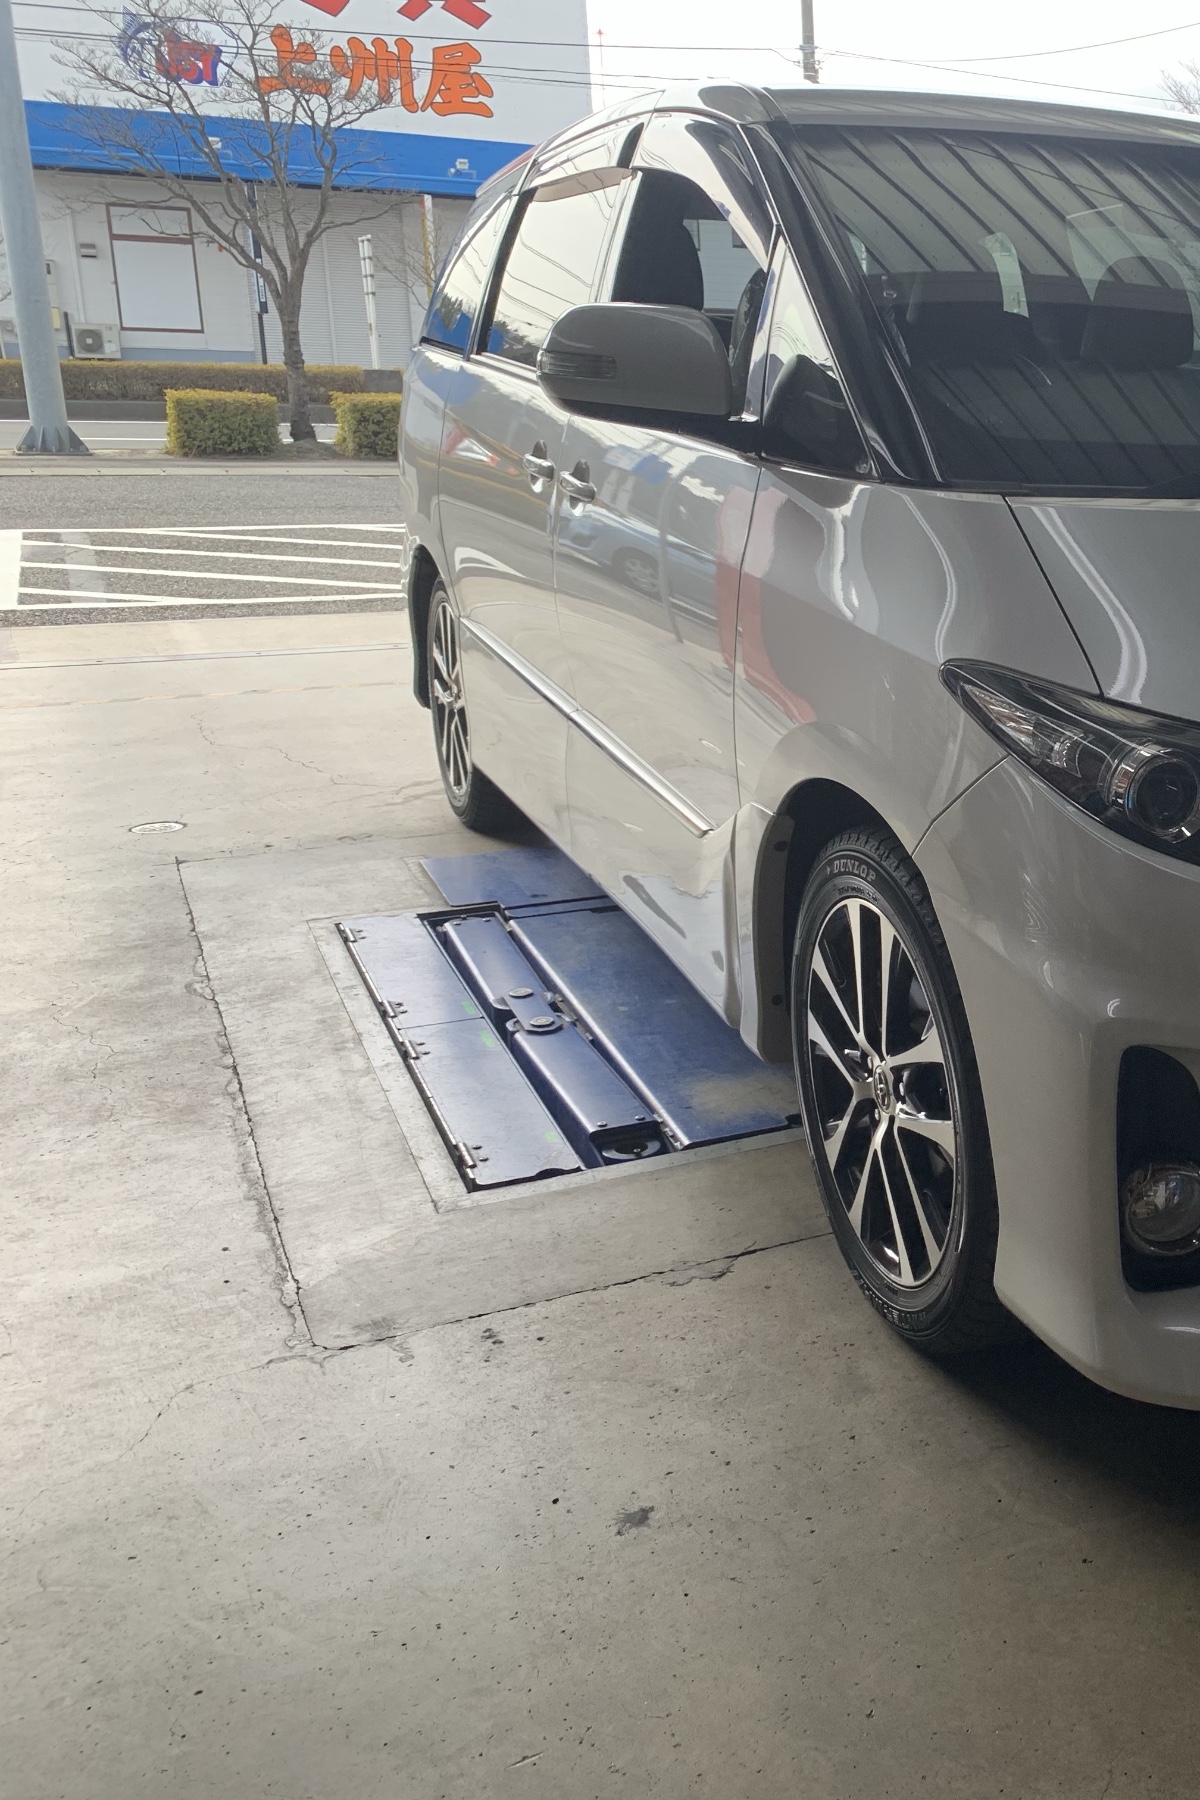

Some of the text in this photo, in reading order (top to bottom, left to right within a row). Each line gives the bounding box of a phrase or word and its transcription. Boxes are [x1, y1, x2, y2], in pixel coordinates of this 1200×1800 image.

[257, 24, 494, 117] 上州屋
[833, 859, 877, 881] DUNLOP
